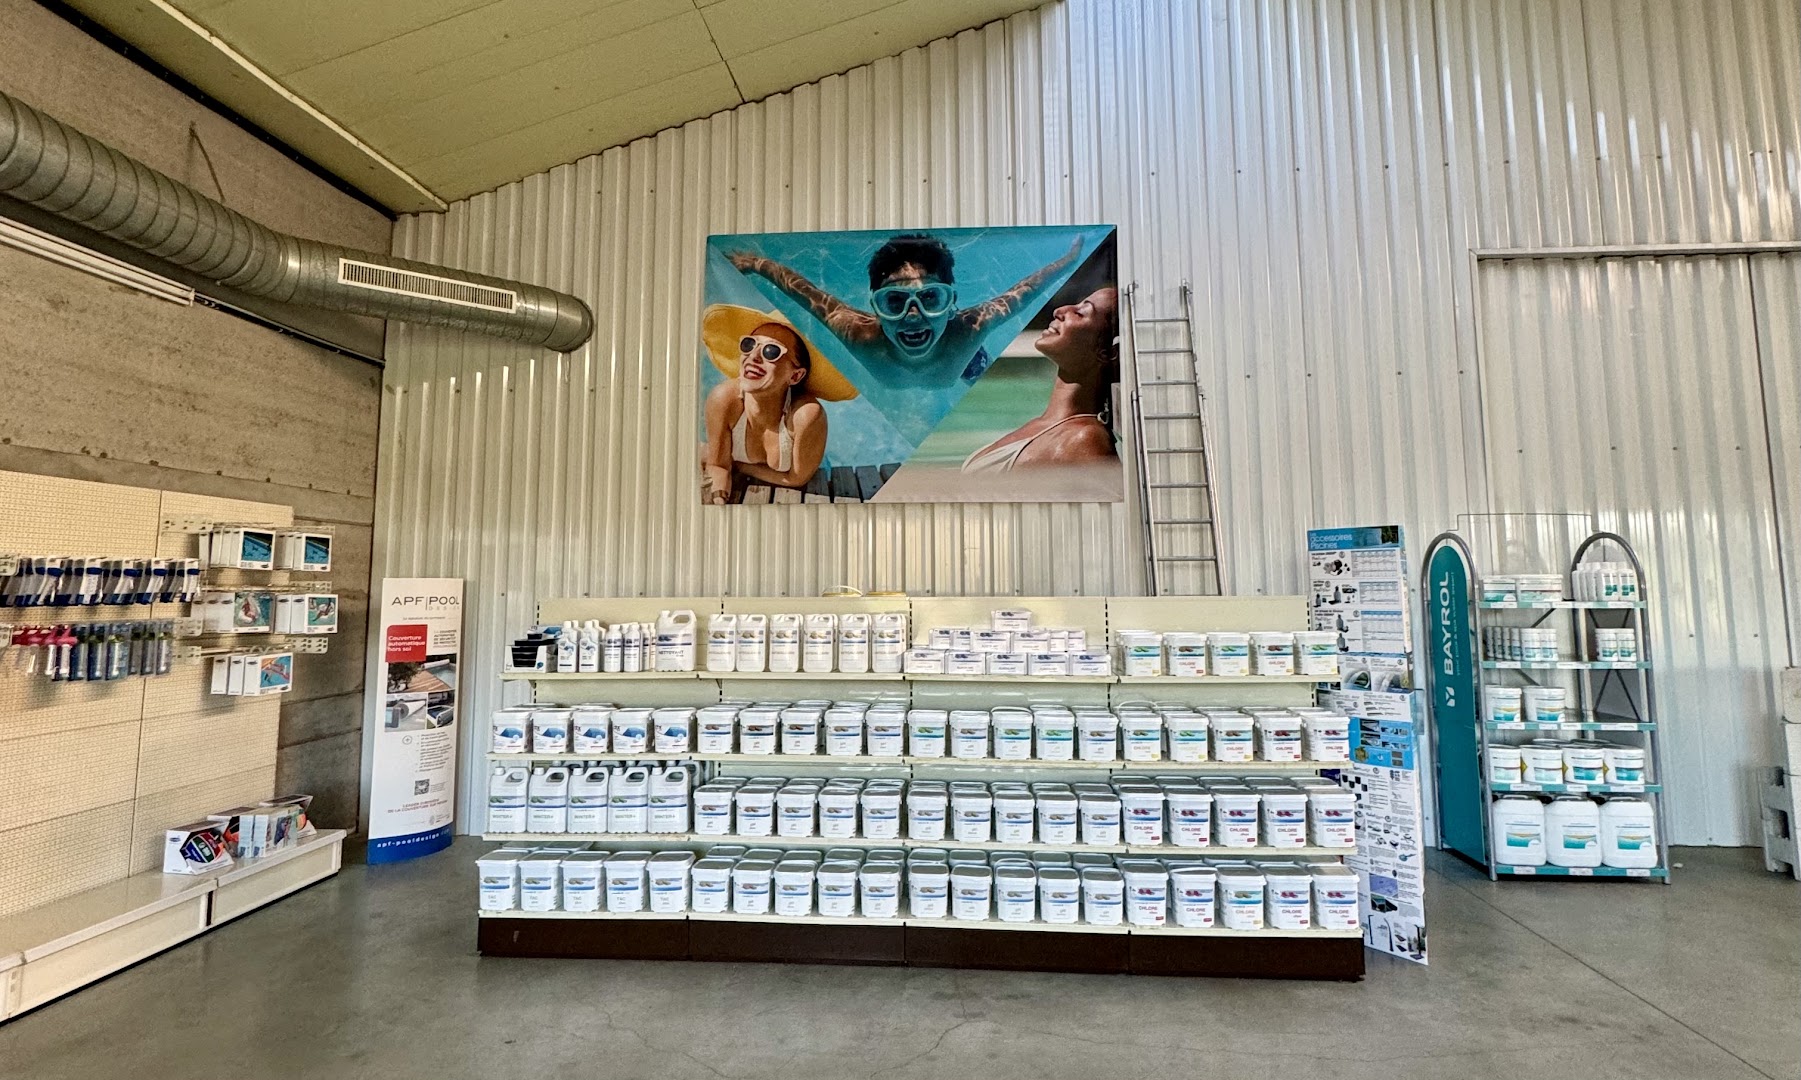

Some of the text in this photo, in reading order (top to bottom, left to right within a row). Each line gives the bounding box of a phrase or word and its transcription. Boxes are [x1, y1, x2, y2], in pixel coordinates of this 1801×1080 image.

[391, 596, 460, 605] APF POOL
[1439, 571, 1454, 675] BAYROL
